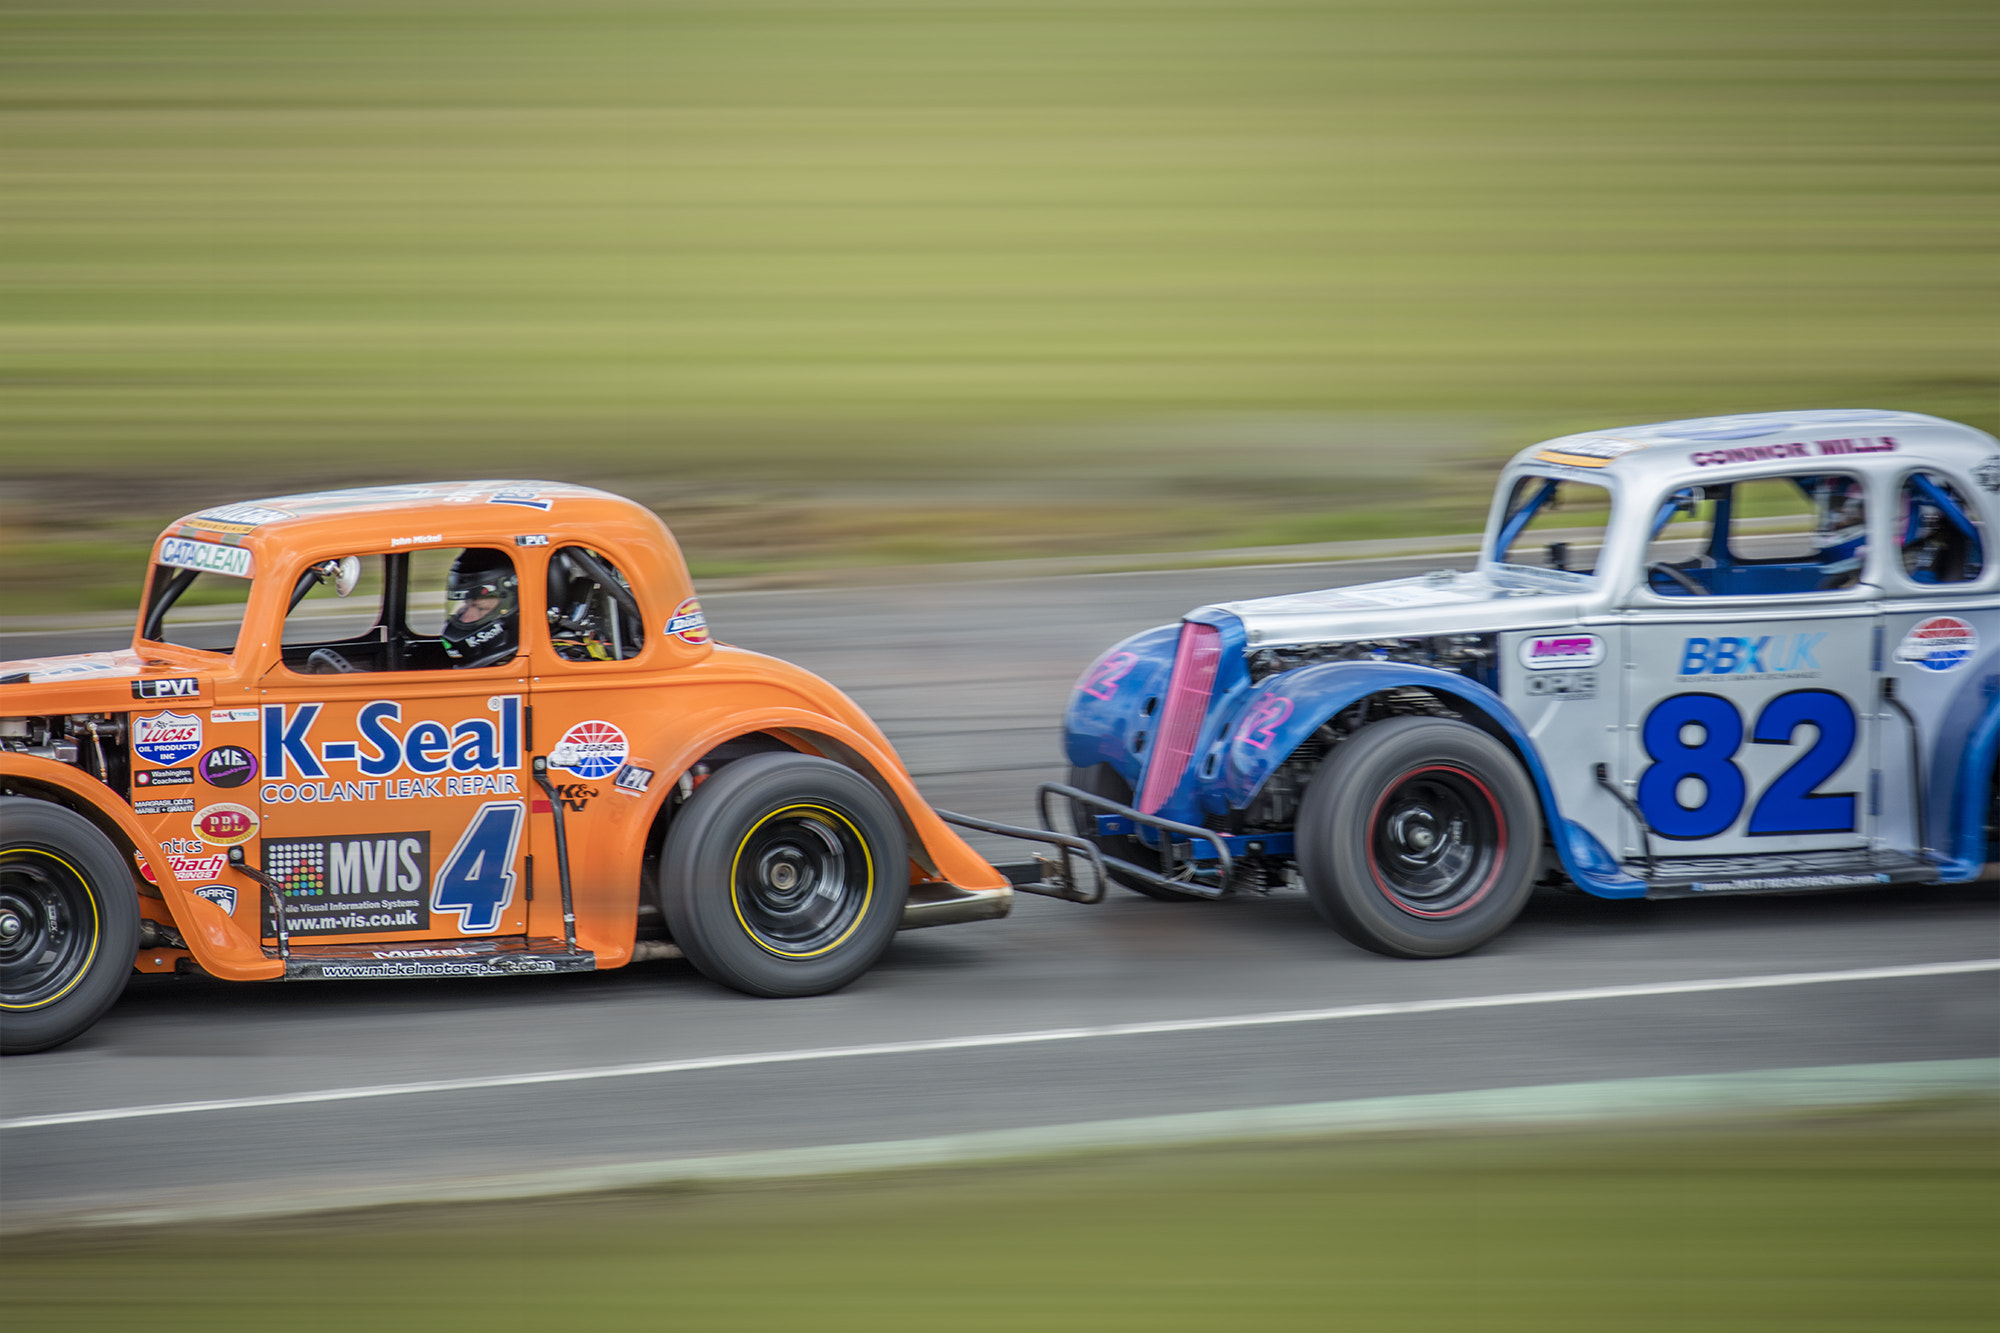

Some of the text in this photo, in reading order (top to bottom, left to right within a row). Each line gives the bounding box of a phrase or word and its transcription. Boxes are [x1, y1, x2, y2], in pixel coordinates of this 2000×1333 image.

[1690, 443, 1810, 467] CONNOR
[162, 540, 249, 573] CATACLEAN
[155, 678, 200, 697] PVL
[141, 727, 196, 743] LUCAS
[154, 743, 198, 752] PRODUCTS
[576, 743, 625, 752] LEGENDS
[151, 769, 191, 777] Washington
[1637, 688, 1860, 841] 82
[151, 776, 193, 785] Coachworks
[260, 774, 521, 804] COOLANT LEAK REPAIR
[208, 814, 245, 832] PBL
[329, 838, 422, 896] MVIS
[429, 800, 526, 934] 4
[300, 903, 328, 912] Visual
[329, 900, 381, 912] Information
[381, 900, 420, 910] Systems
